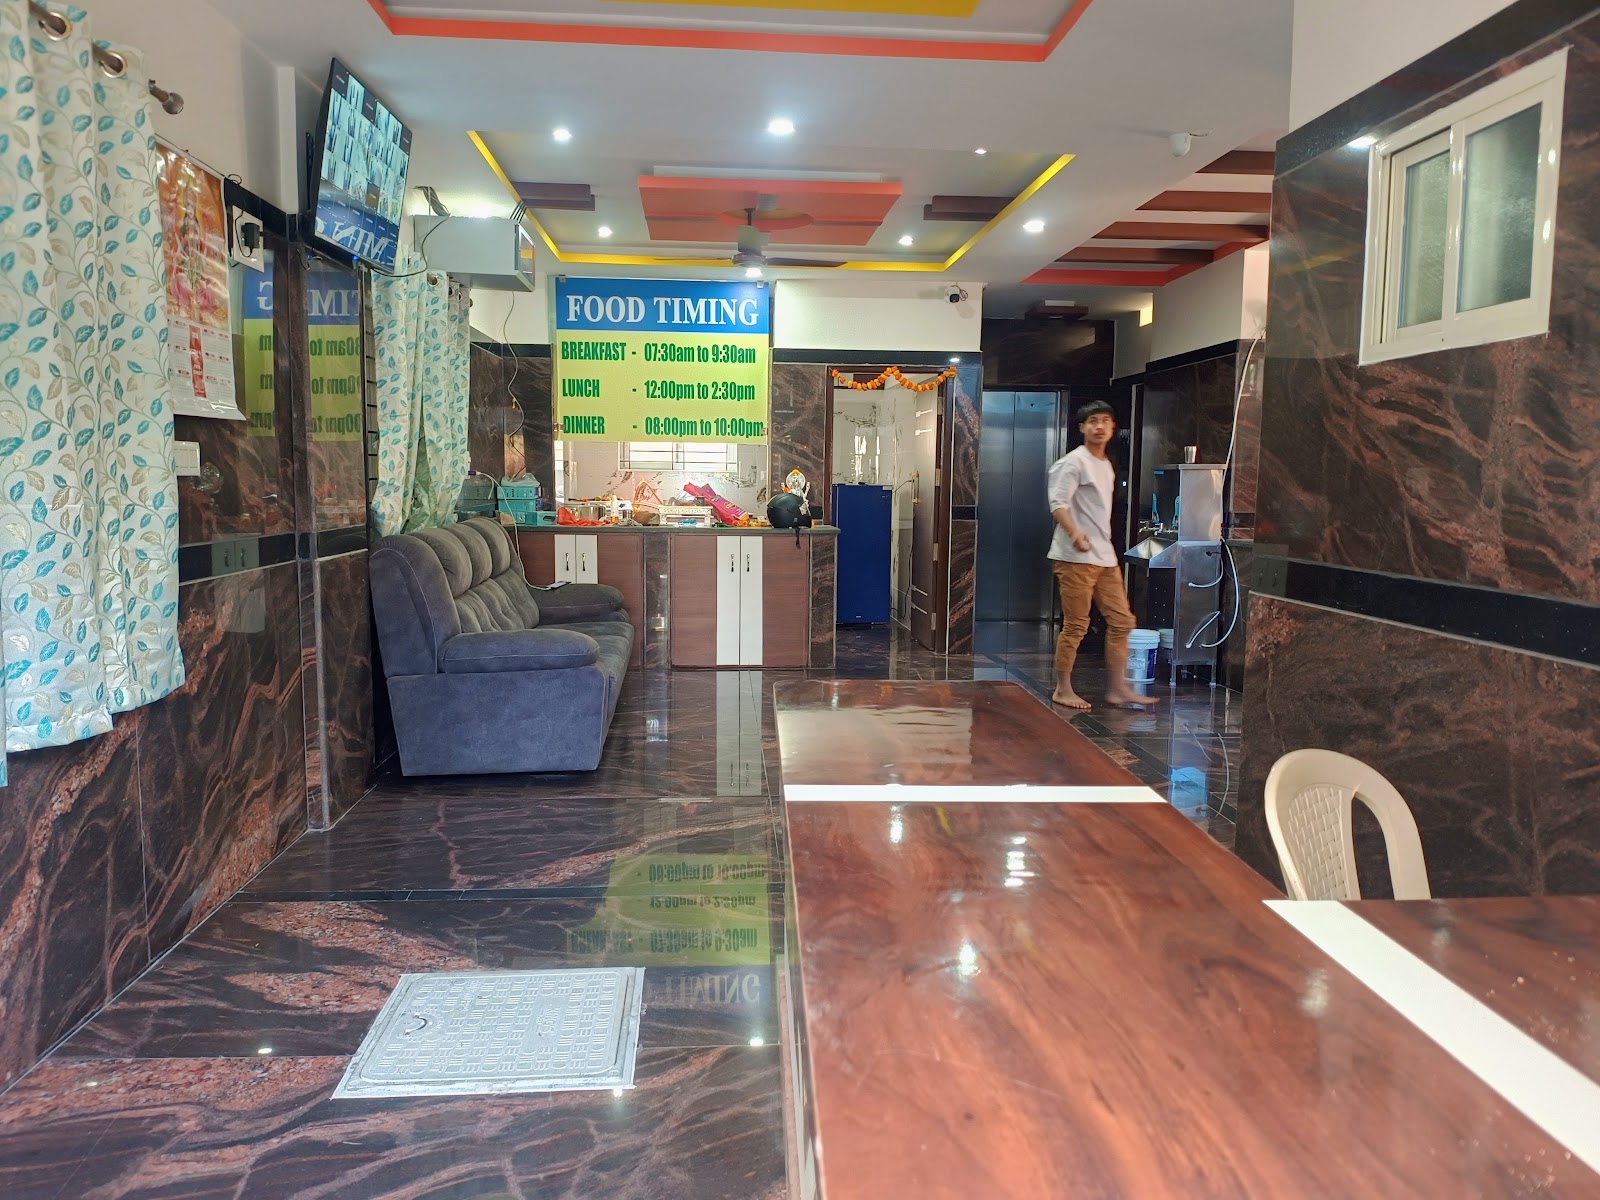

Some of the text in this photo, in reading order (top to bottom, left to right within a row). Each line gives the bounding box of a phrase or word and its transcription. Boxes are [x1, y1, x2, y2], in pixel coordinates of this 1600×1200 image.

[566, 295, 759, 326] FOOD TIMING
[561, 341, 627, 361] BREAKFAST
[644, 342, 695, 363] 07:30am
[697, 345, 709, 362] to
[711, 344, 756, 364] 9:30am
[562, 378, 600, 398] LUNCH
[644, 379, 695, 401] 12:00pm
[697, 382, 709, 400] to
[711, 381, 755, 401] 2:30pm
[562, 415, 605, 435] DINNER
[645, 416, 697, 438] 08:00pm
[700, 419, 712, 437] to
[714, 417, 764, 439] 10:00pm
